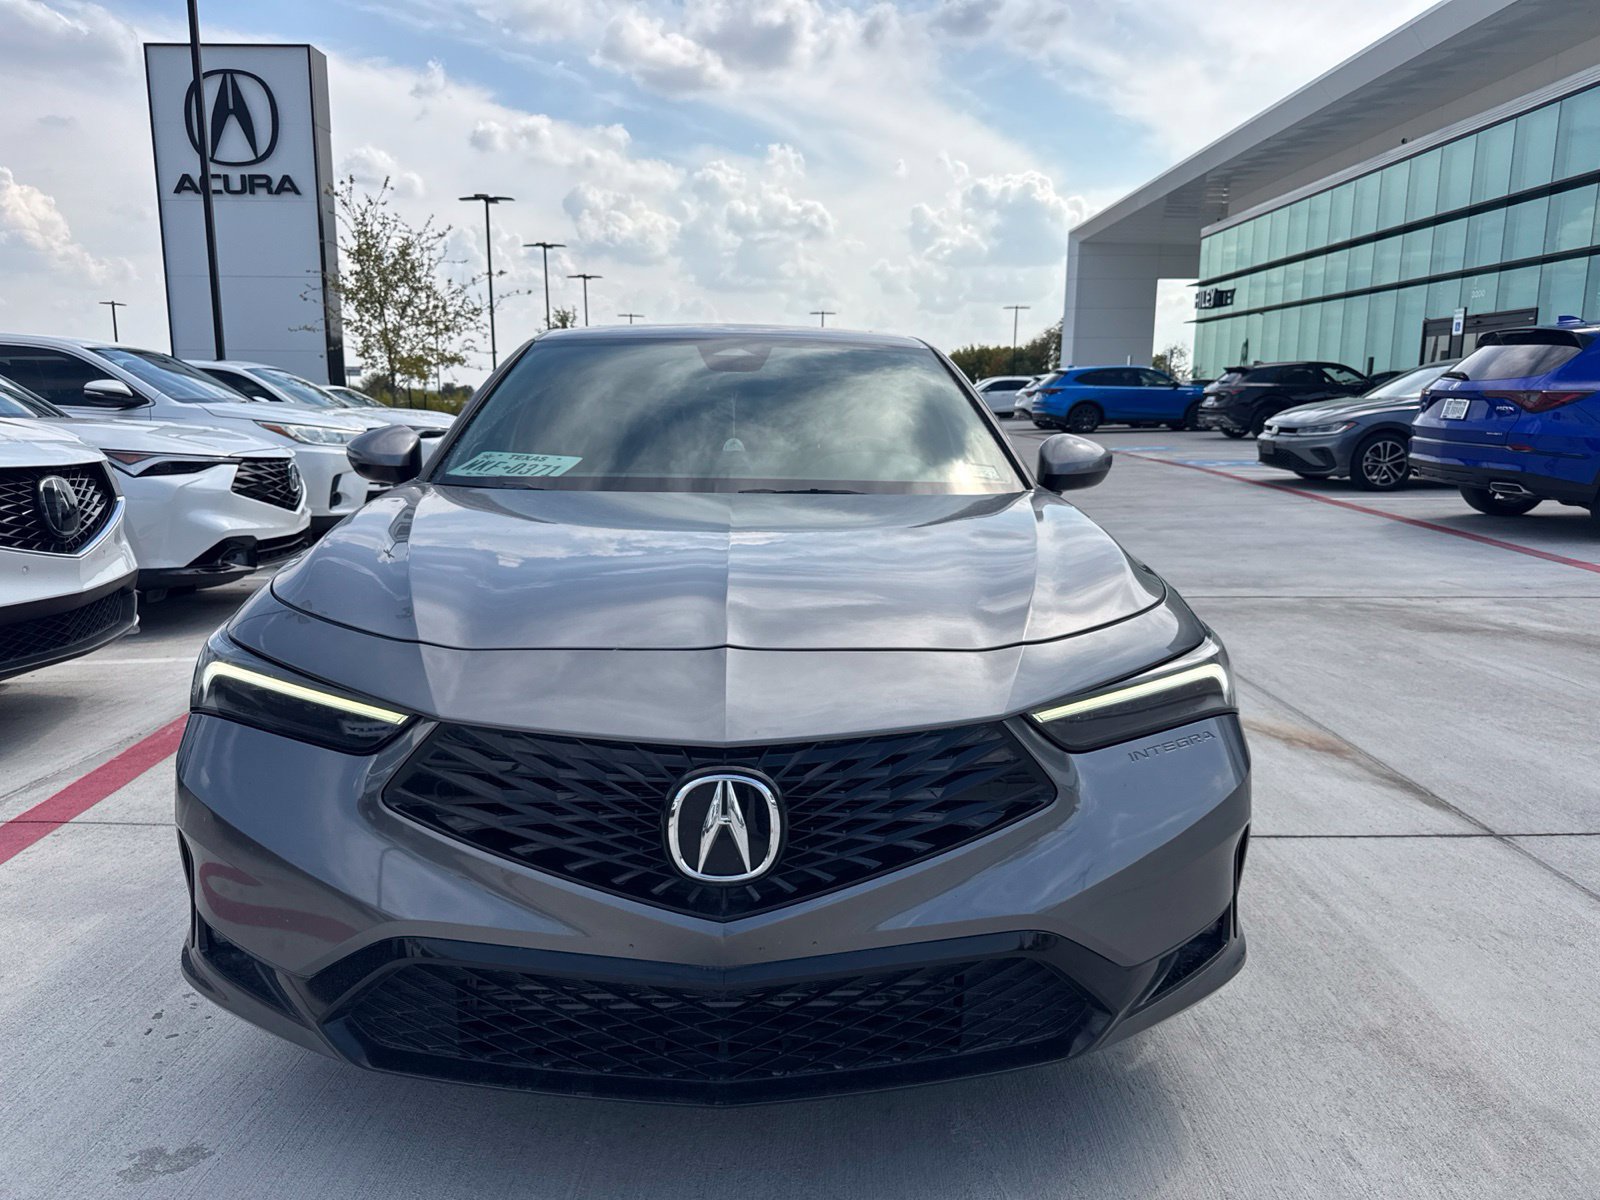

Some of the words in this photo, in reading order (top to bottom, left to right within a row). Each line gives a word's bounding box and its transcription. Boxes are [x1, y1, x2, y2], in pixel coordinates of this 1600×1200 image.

[173, 173, 302, 195] ACURA
[508, 454, 548, 462] TEXAS
[1127, 730, 1217, 762] INTEGRA
